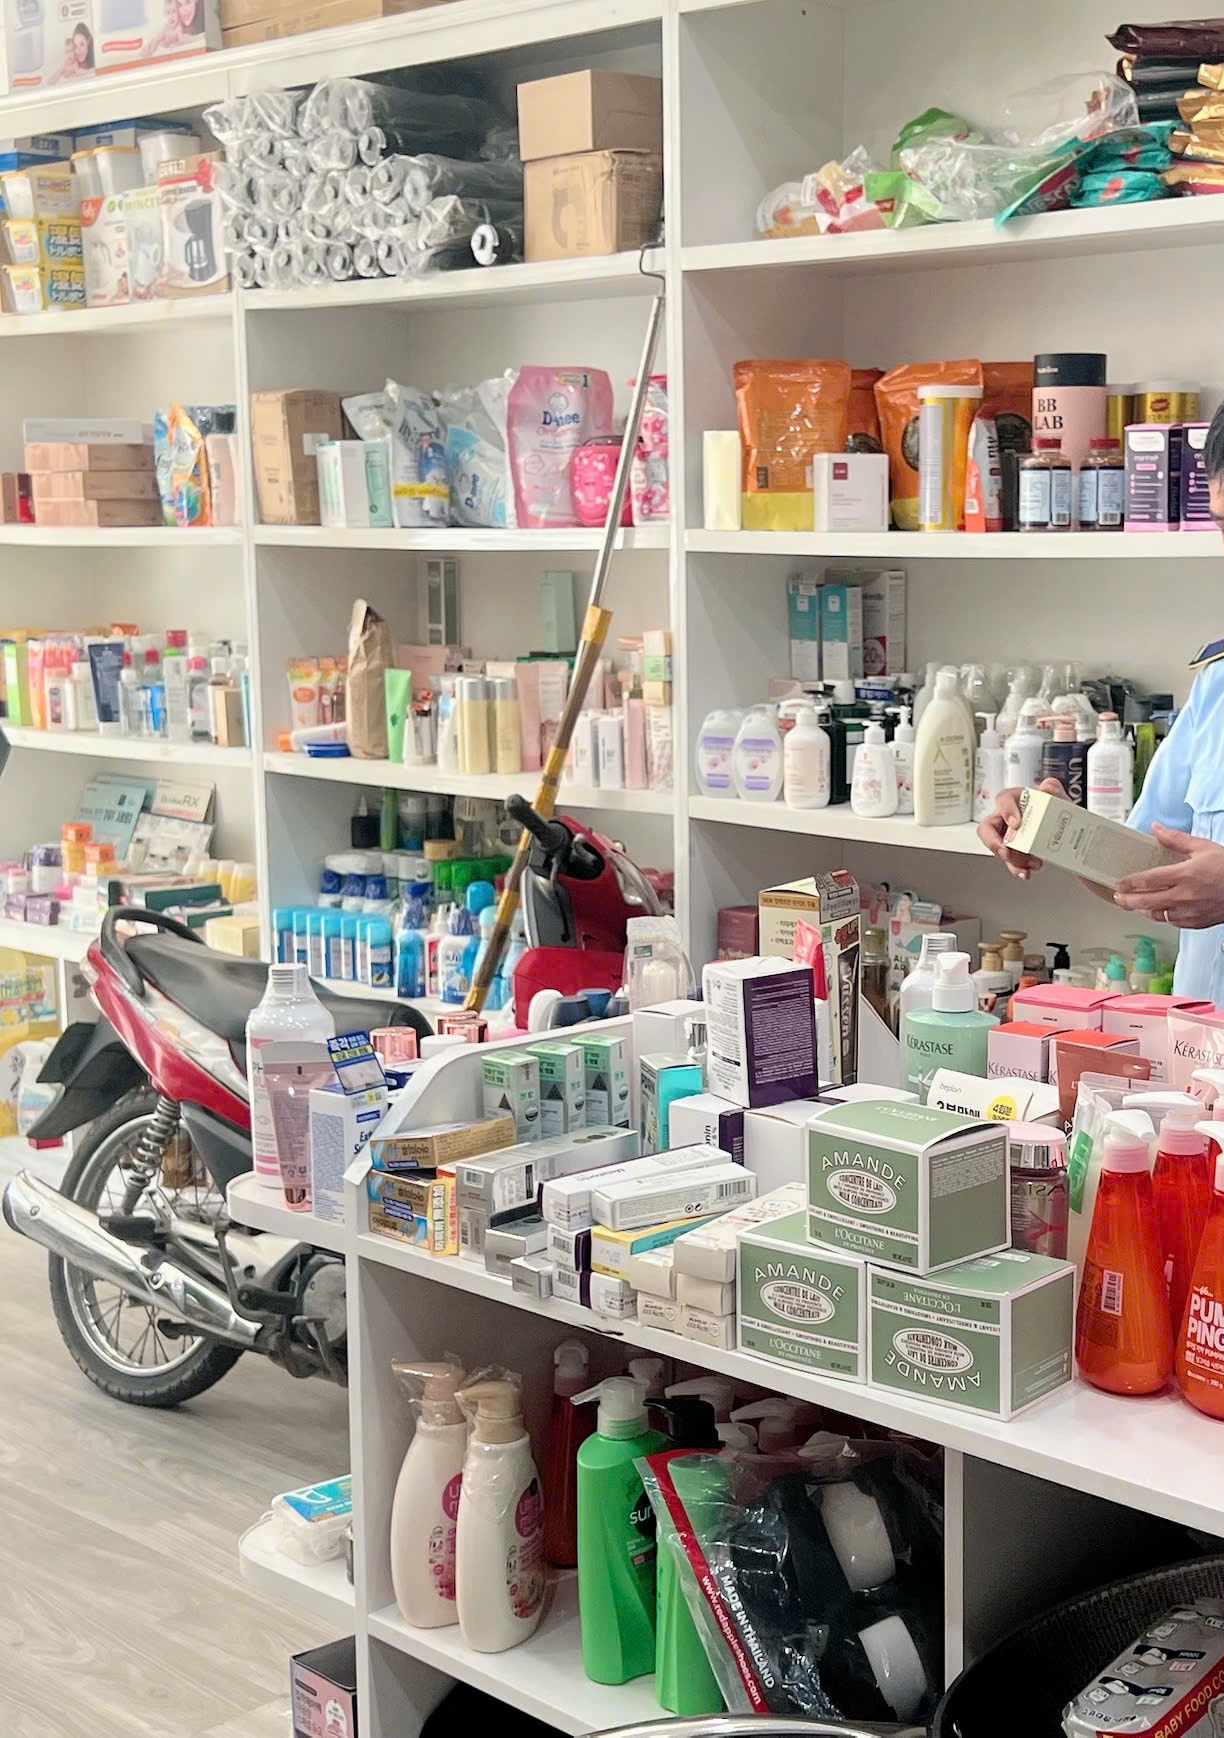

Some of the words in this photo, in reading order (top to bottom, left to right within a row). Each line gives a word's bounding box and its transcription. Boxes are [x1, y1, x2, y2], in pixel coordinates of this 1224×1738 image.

[1037, 398, 1057, 413] BB
[1034, 416, 1063, 430] LAB
[906, 1032, 954, 1056] KÉRASTASE
[1174, 1040, 1224, 1066] KÉRASTASE
[988, 1061, 1039, 1082] KÉRASTASE
[821, 1151, 906, 1191] AMANDE
[834, 1228, 885, 1250] L'OCCITANE
[754, 1263, 845, 1301] AMANDE
[903, 1291, 961, 1313] L'OCCITANE
[769, 1338, 823, 1359] L'OCCITANE
[884, 1349, 982, 1392] AMANDE
[702, 1575, 762, 1705] www.redappleshoes.com
[721, 1575, 743, 1611] MADE
[742, 1625, 775, 1689] THAILAND
[1154, 1715, 1184, 1738] BABY
[1184, 1684, 1213, 1717] FOOD
